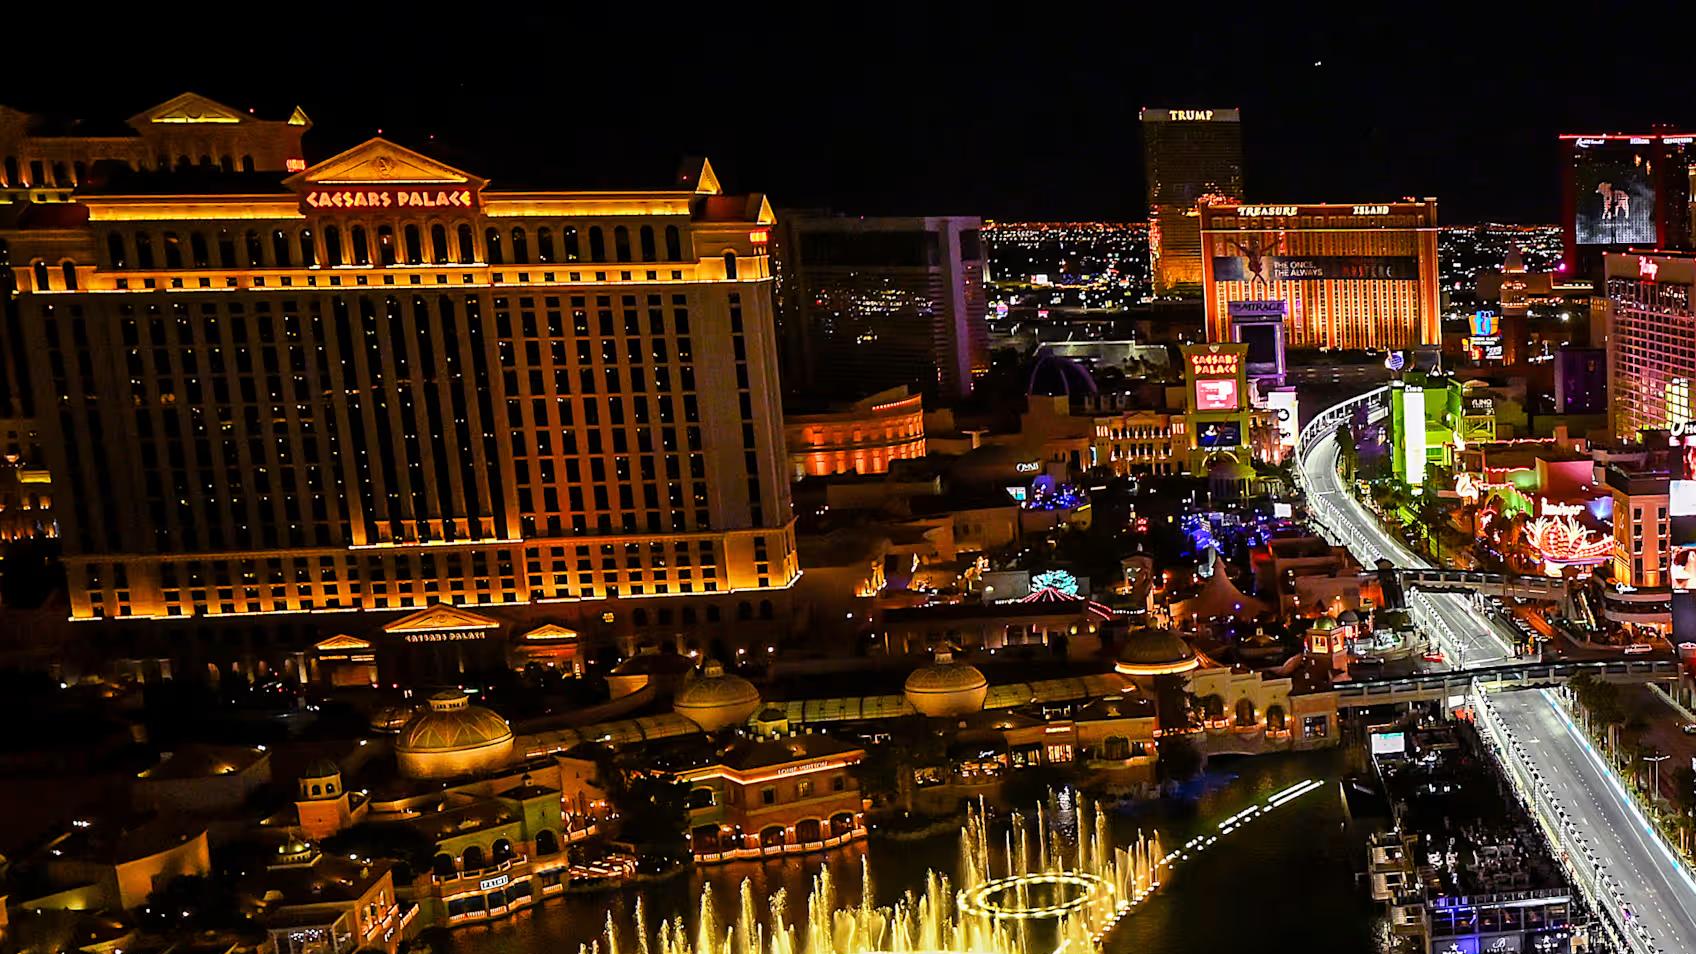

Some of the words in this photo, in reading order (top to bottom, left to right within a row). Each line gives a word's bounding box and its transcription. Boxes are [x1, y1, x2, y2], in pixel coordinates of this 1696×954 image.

[1169, 109, 1214, 121] TRUMP
[306, 191, 392, 208] CAESARS
[397, 190, 473, 207] PALACE
[1237, 206, 1298, 217] TREASURE
[1353, 205, 1390, 215] ISLAND
[1273, 268, 1289, 277] THE
[1290, 268, 1323, 277] ALWAYS
[1191, 354, 1238, 365] CAESARS
[1194, 364, 1237, 375] PALACE
